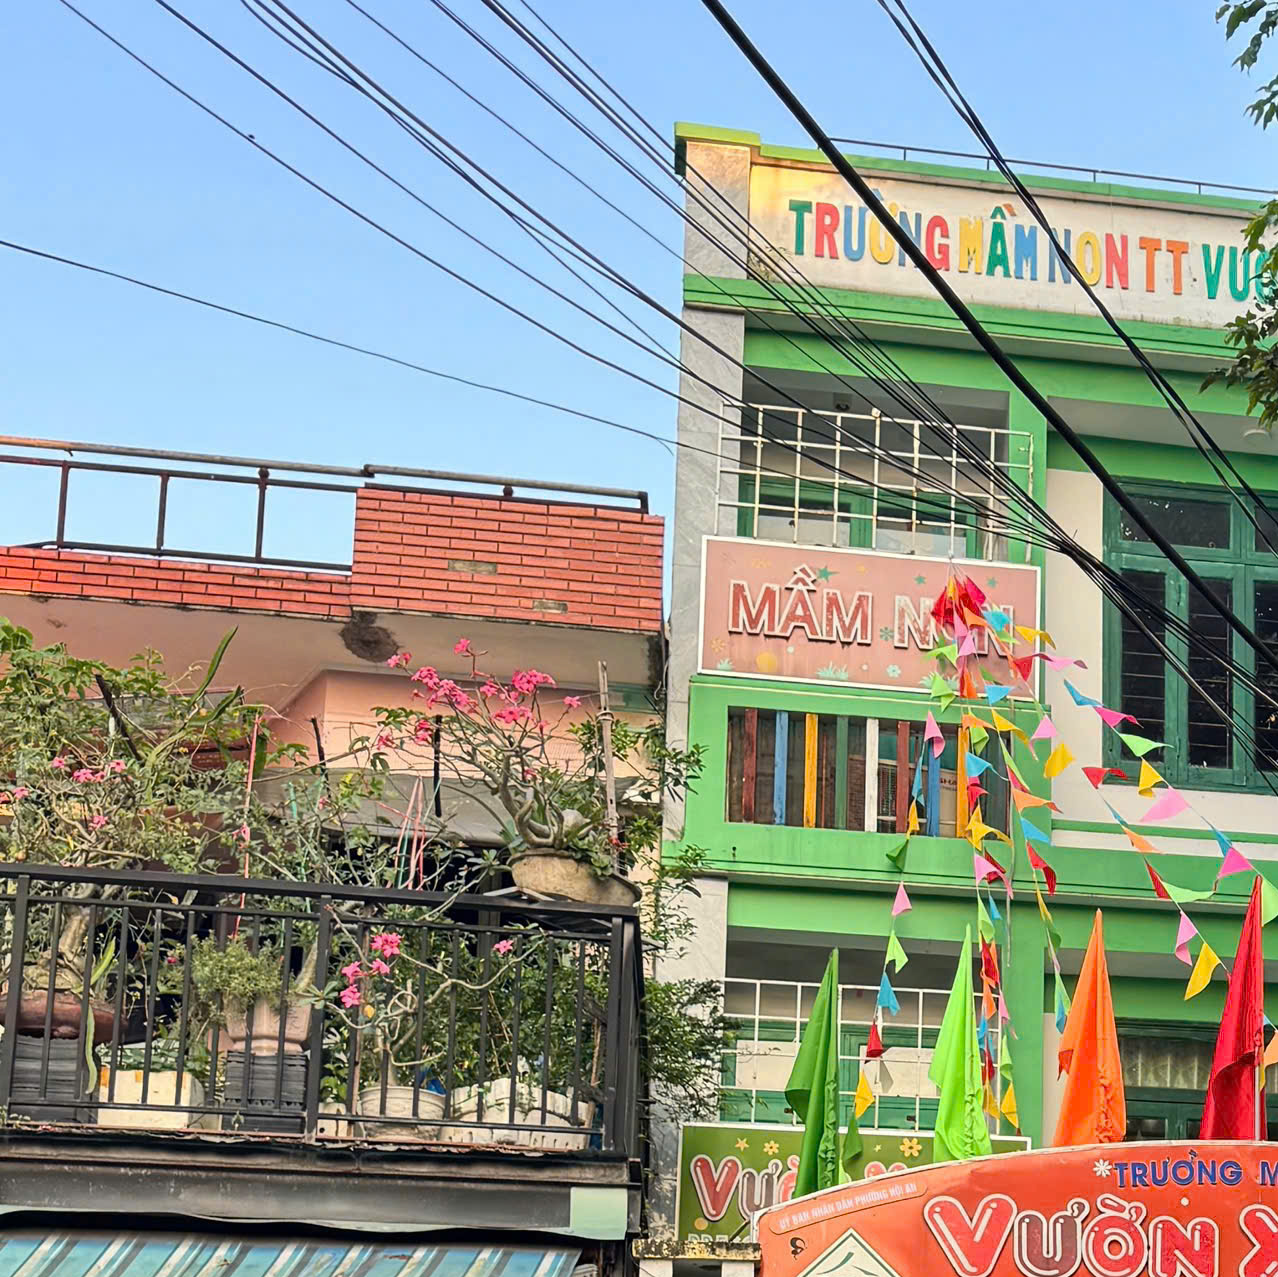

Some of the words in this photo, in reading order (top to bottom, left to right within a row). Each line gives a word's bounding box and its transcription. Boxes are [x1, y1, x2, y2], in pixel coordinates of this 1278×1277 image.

[958, 203, 1038, 281] MẦM
[1048, 227, 1129, 291] NON
[1139, 235, 1190, 295] TT
[728, 564, 873, 645] MẦM
[893, 596, 1015, 657] NN
[1113, 1149, 1244, 1189] TRƯỜNG
